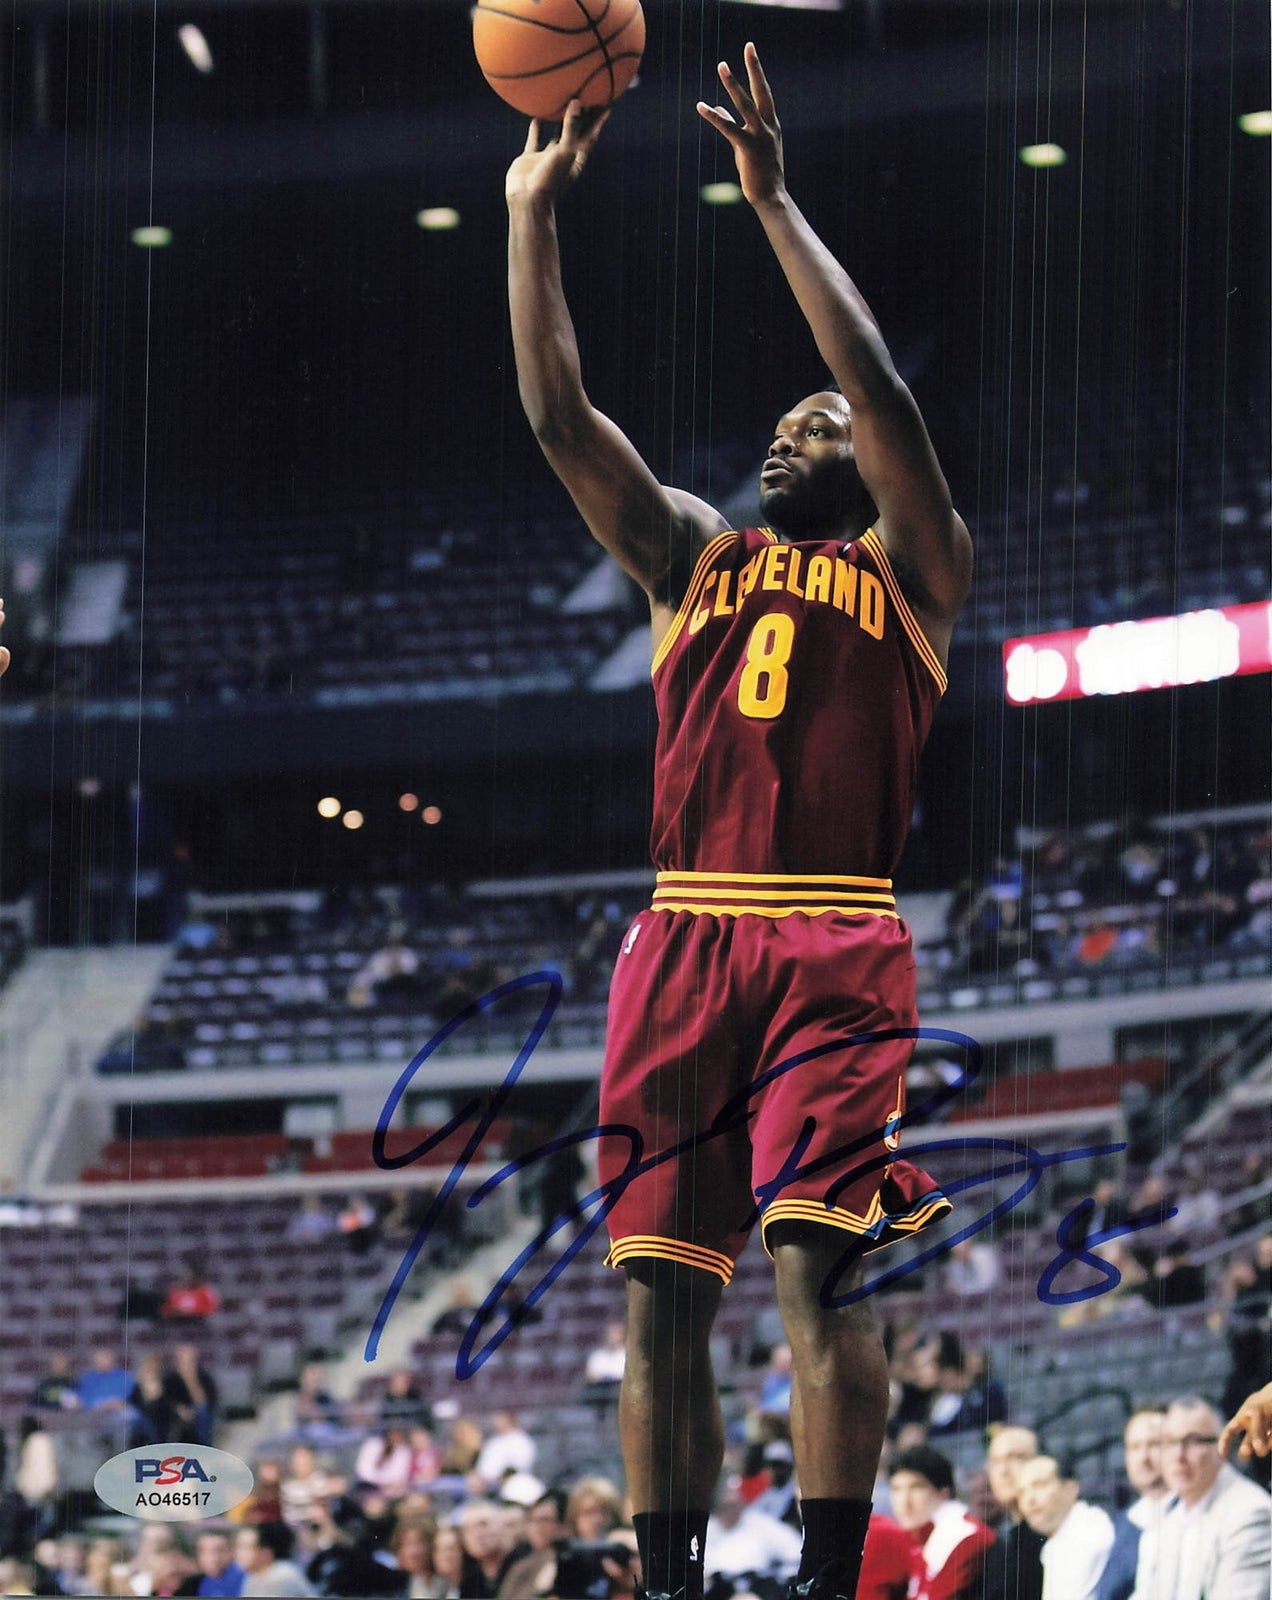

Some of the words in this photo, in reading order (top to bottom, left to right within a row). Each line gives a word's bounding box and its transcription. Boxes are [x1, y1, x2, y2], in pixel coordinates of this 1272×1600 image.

[738, 613, 795, 719] 8
[135, 1456, 210, 1485] PSA
[135, 1492, 211, 1506] AO46517
